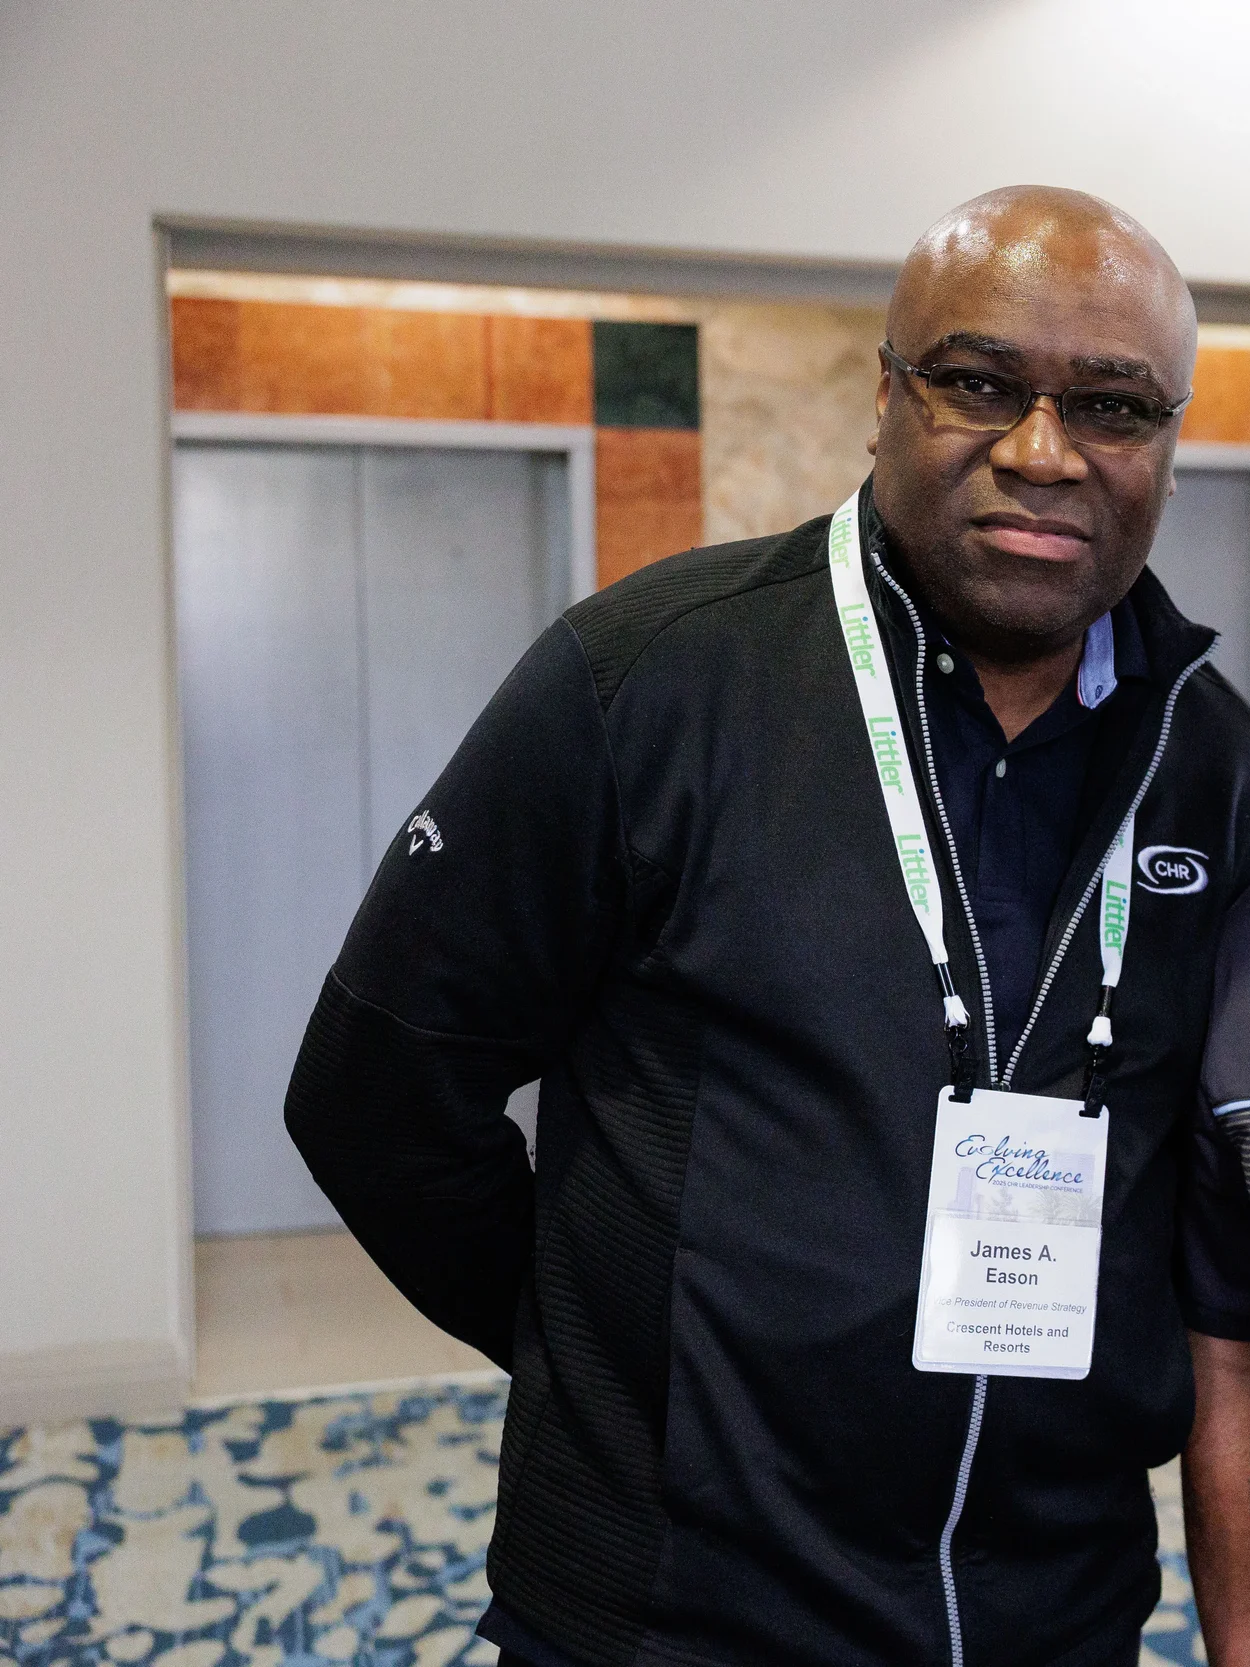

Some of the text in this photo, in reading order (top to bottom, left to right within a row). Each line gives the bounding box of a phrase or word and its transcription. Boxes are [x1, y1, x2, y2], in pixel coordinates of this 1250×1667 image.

[840, 603, 877, 679] Littler
[868, 717, 903, 793] Littler
[897, 834, 929, 914] Littler
[1155, 860, 1191, 880] CHR
[1104, 879, 1127, 955] Littler
[955, 1134, 1049, 1161] Evolving
[976, 1157, 1084, 1184] Excellence
[1019, 1182, 1050, 1191] LEADERSHIP
[1050, 1185, 1084, 1194] CONFERENCE
[970, 1239, 1058, 1263] James A.
[985, 1267, 1039, 1286] Eason
[954, 1297, 997, 1309] President
[998, 1299, 1009, 1309] of
[1010, 1300, 1049, 1311] Revenue
[1051, 1302, 1088, 1315] Strategy
[946, 1321, 1069, 1338] Crescent Hotels and
[983, 1340, 1031, 1354] Resorts
